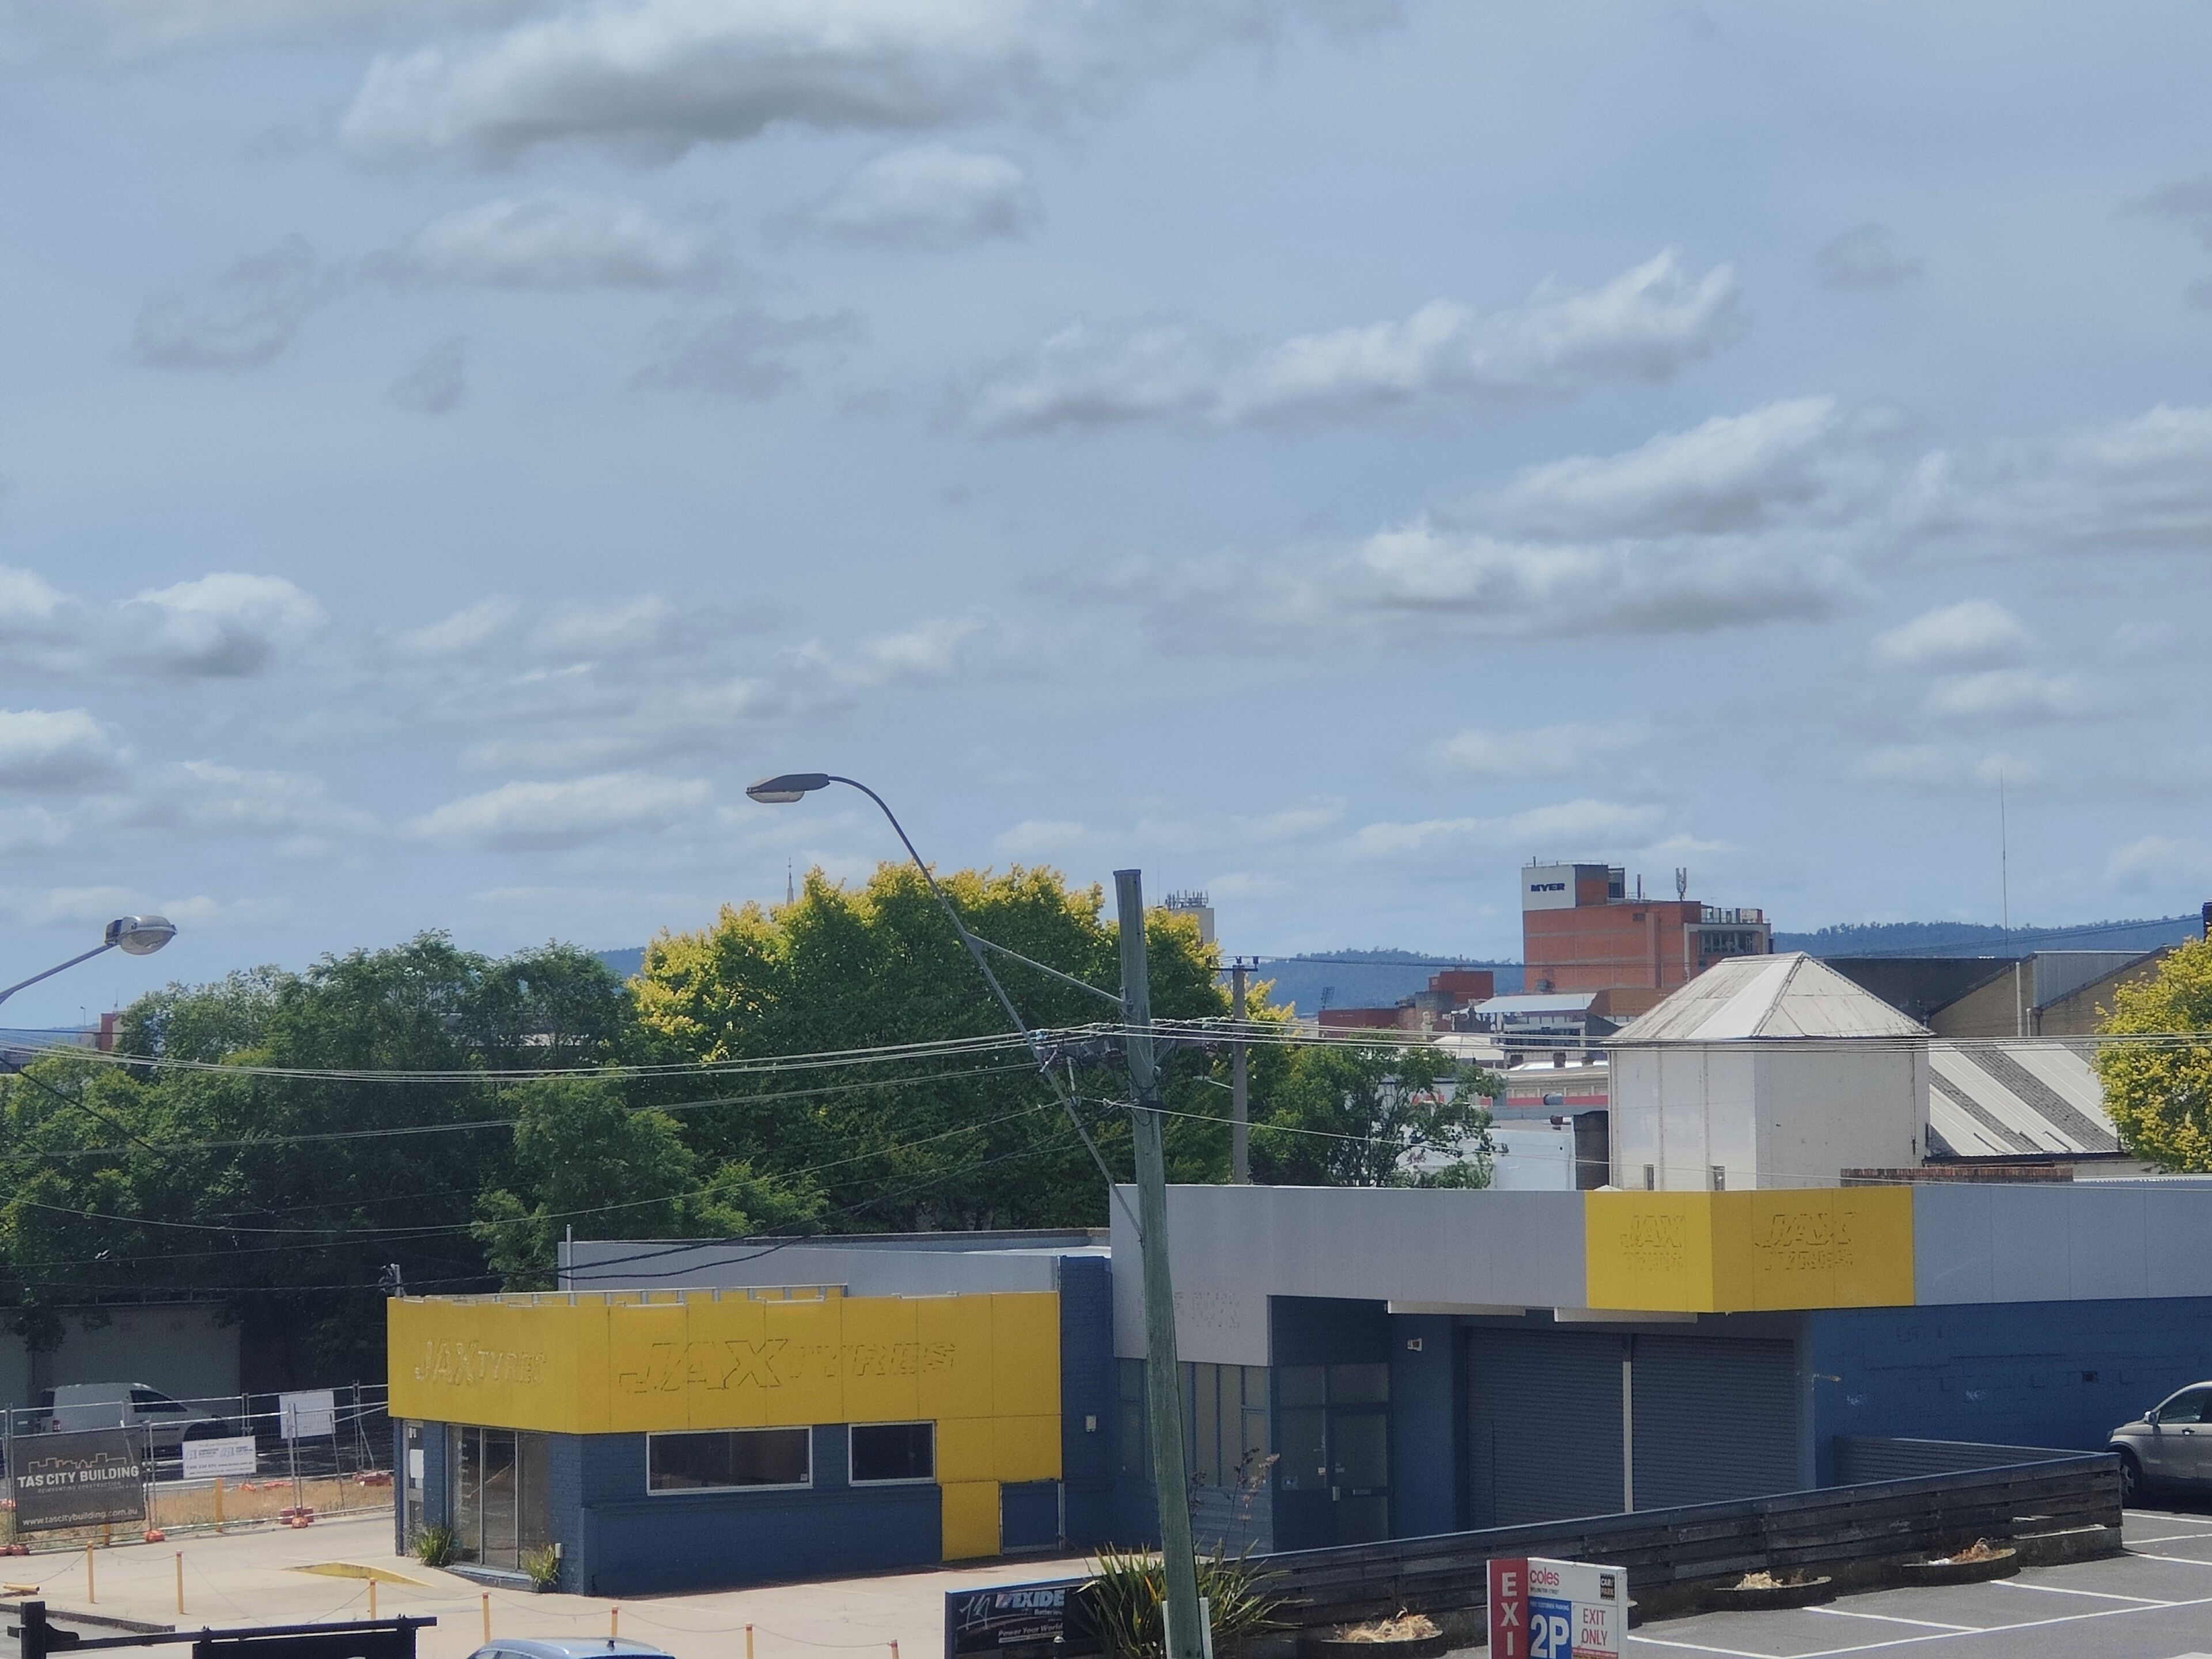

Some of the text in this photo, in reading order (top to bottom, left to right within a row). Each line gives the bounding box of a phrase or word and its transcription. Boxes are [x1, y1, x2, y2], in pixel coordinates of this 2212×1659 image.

[1531, 882, 1566, 892] MYER
[17, 1465, 140, 1488] TAS CITY BUILDING
[22, 1507, 138, 1526] www.tascitybuilding.com.au
[1529, 1567, 1560, 1586] coles
[1012, 1589, 1066, 1608] EXIDE
[1583, 1608, 1606, 1626] EXIT
[1040, 1623, 1063, 1632] World
[1530, 1614, 1570, 1659] 2P
[1581, 1628, 1608, 1646] ONLY
